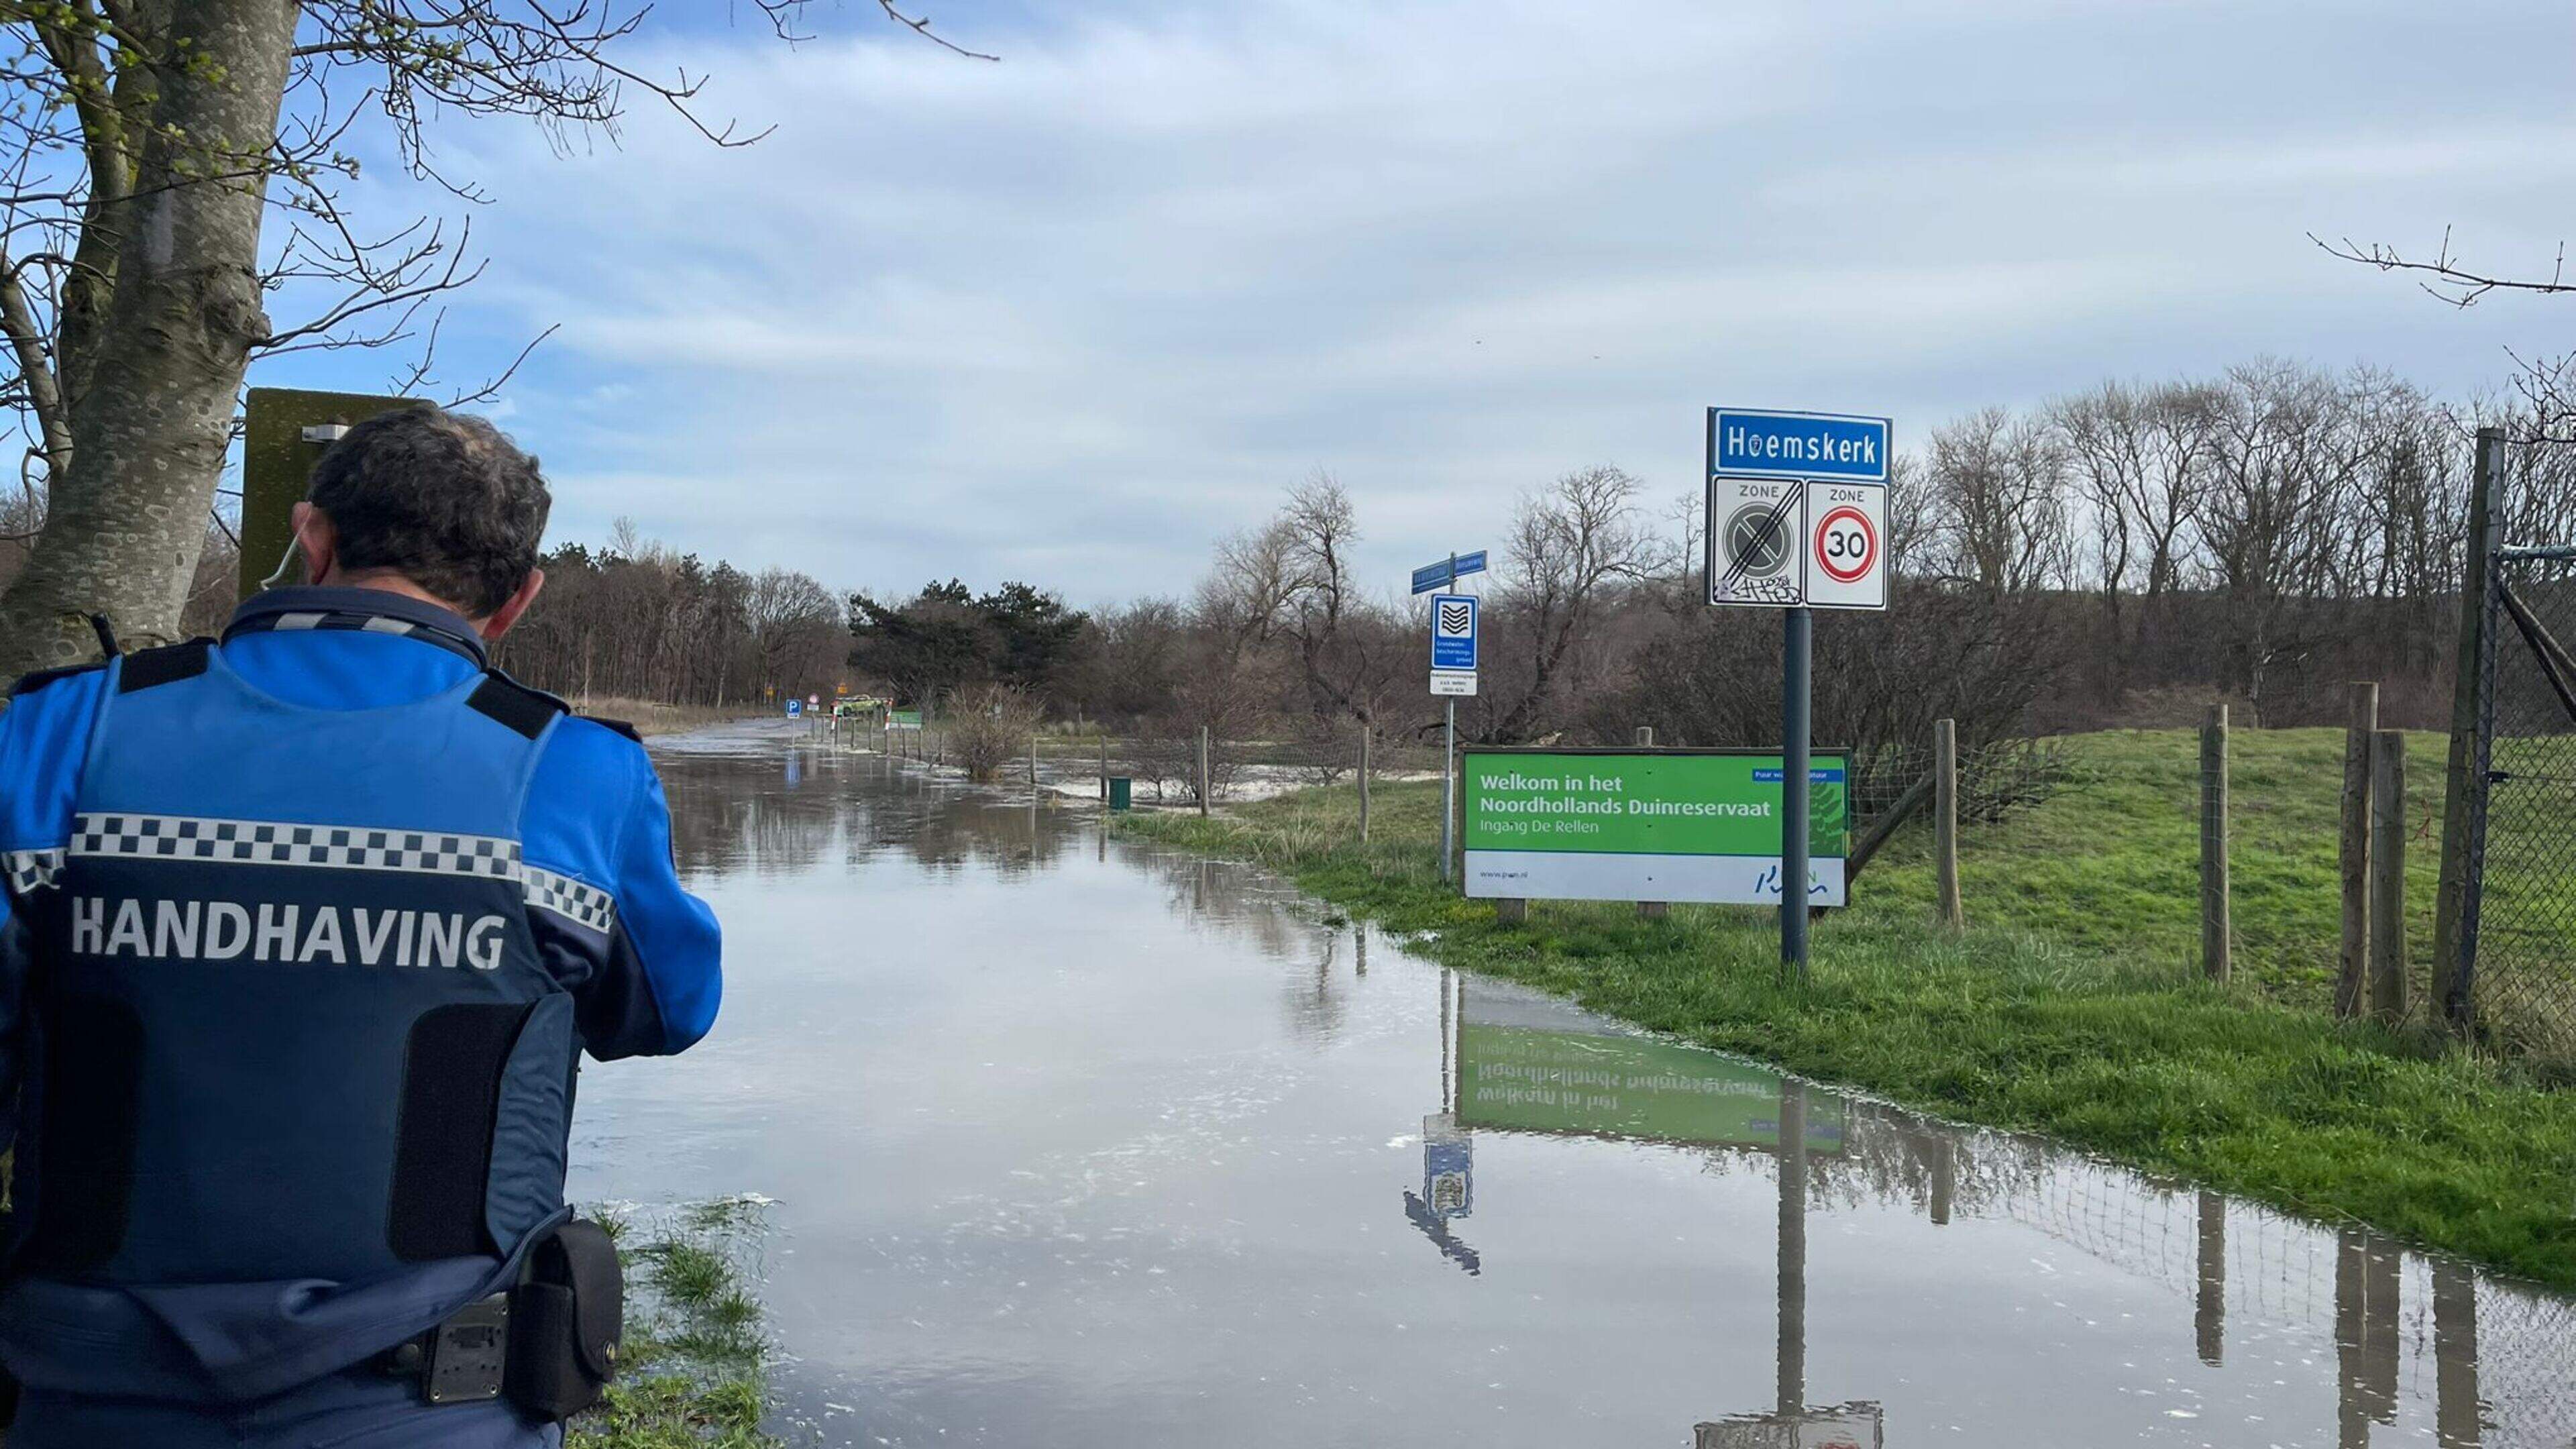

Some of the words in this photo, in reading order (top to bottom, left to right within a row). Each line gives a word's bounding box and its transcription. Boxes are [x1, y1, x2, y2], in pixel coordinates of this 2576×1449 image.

[1739, 485, 1779, 498] ZONE
[1829, 489, 1864, 502] ZONE
[1827, 531, 1865, 558] 30
[789, 701, 797, 712] P
[1481, 774, 1558, 791] Welkom
[1565, 775, 1583, 791] in
[1589, 775, 1622, 792] het
[1481, 797, 1622, 814] Noordhollands
[1629, 799, 1771, 816] Duinreservaat
[1481, 819, 1527, 835] Ingang
[1532, 820, 1551, 833] De
[1556, 820, 1599, 833] Rellen
[72, 896, 506, 971] HANDHAVING
